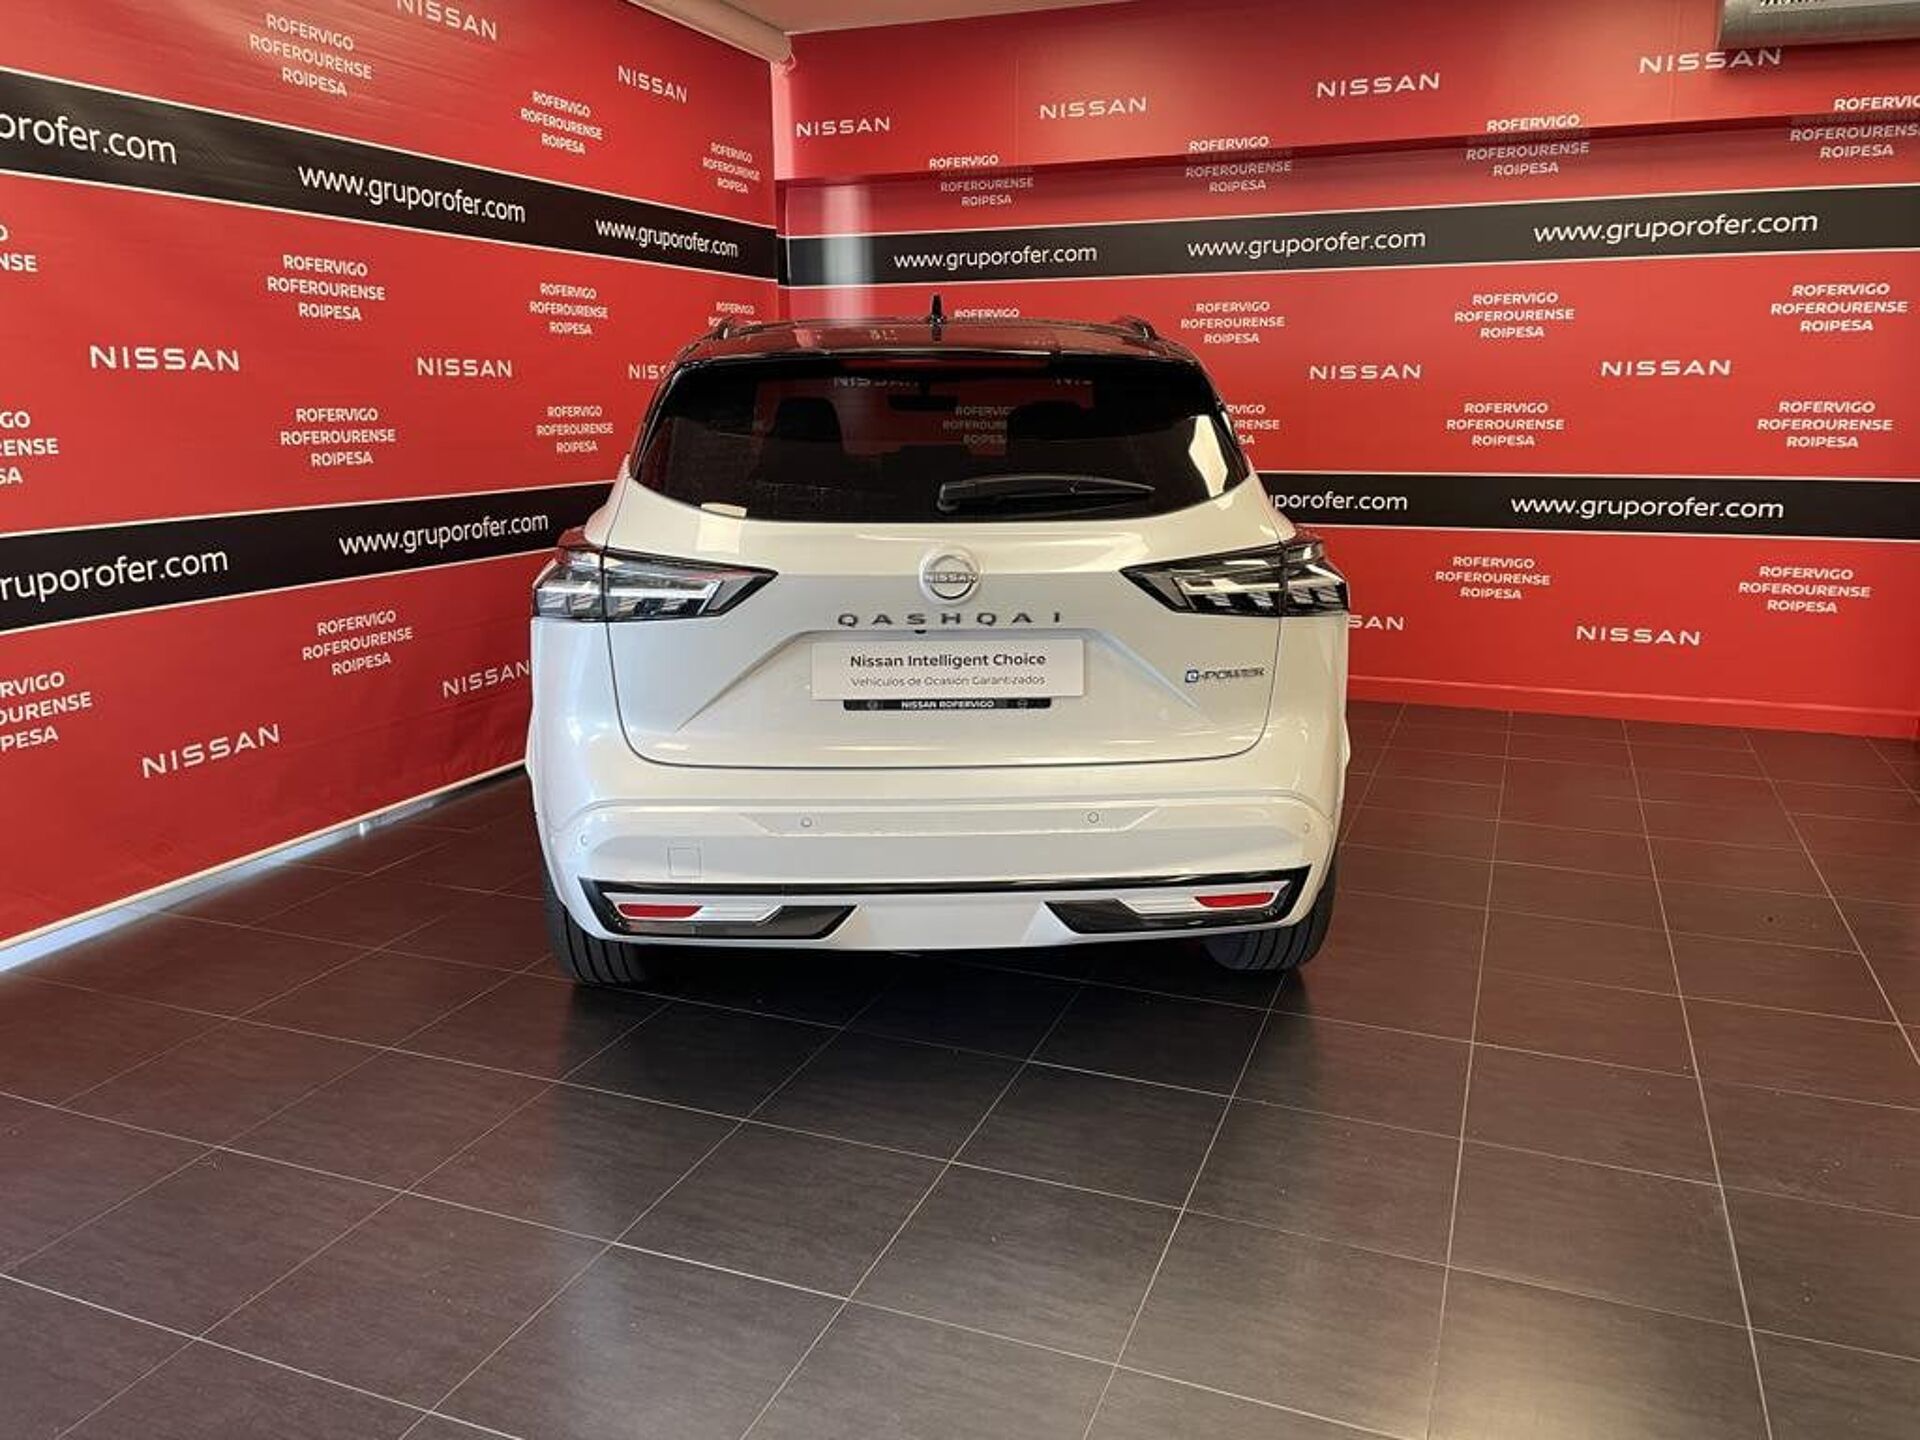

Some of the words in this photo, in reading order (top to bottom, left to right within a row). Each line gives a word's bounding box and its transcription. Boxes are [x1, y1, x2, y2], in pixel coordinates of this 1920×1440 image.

[396, 0, 497, 41] NISSAN
[266, 13, 354, 51] ROFERVIGO
[249, 34, 373, 80] ROFEROURENSE
[1640, 48, 1780, 75] NISSAN
[282, 67, 348, 97] ROIPESA
[617, 64, 688, 104] NISSAN
[1317, 73, 1440, 99] NISSAN
[533, 91, 591, 118] ROFERVIGO
[1040, 97, 1147, 120] NISSAN
[521, 108, 603, 140] ROFEROURENSE
[795, 116, 890, 137] NISSAN
[1487, 114, 1580, 132] ROFERVIGO
[541, 132, 586, 155] ROIPESA
[1189, 136, 1269, 152] ROFERVIGO
[1466, 142, 1590, 161] ROFEROURENSE
[1820, 144, 1894, 158] ROIPESA
[929, 154, 999, 170] ROFERVIGO
[1185, 160, 1292, 178] ROFEROURENSE
[1493, 162, 1559, 177] ROIPESA
[298, 165, 526, 223] www.gruporofer.com
[1209, 179, 1266, 193] ROIPESA
[961, 194, 1012, 207] ROIPESA
[1534, 214, 1818, 244] www.gruporofer.com
[596, 219, 738, 258] www.gruporofer.com
[1187, 230, 1425, 260] www.gruporofer.com
[282, 254, 368, 277] ROFERVIGO
[894, 245, 1098, 271] www.gruporofer.com
[267, 277, 385, 300] ROFEROURENSE
[540, 283, 597, 300] ROFERVIGO
[1792, 283, 1890, 298] ROFERVIGO
[1195, 301, 1270, 313] ROFERVIGO
[1472, 292, 1558, 306] ROFERVIGO
[298, 302, 362, 321] ROIPESA
[529, 301, 608, 320] ROFEROURENSE
[1454, 308, 1575, 322] ROFEROURENSE
[1771, 301, 1908, 316] ROFEROURENSE
[548, 321, 593, 335] ROIPESA
[1180, 316, 1285, 329] ROFEROURENSE
[1800, 319, 1873, 332] ROIPESA
[1203, 332, 1260, 345] ROIPESA
[1480, 326, 1544, 339] ROIPESA
[90, 345, 240, 372] NISSAN
[417, 357, 513, 379] NISSAN
[1310, 364, 1421, 380] NISSAN
[1600, 360, 1731, 377] NISSAN
[296, 408, 379, 424] ROFERVIGO
[547, 405, 602, 418] ROFERVIGO
[1464, 402, 1548, 414] ROFERVIGO
[1779, 401, 1875, 414] ROFERVIGO
[537, 422, 614, 437] ROFEROURENSE
[1446, 418, 1564, 431] ROFEROURENSE
[1757, 418, 1893, 431] ROFEROURENSE
[281, 429, 396, 446] ROFEROURENSE
[1471, 434, 1535, 447] ROIPESA
[1786, 436, 1858, 448] ROIPESA
[556, 440, 598, 453] ROIPESA
[310, 451, 374, 468] ROIPESA
[1511, 496, 1784, 521] www.gruporofer.com
[339, 513, 549, 556] www.gruporofer.com
[1452, 556, 1535, 569] ROFERVIGO
[1435, 571, 1550, 586] ROFEROURENSE
[1759, 565, 1853, 580] ROFERVIGO
[1460, 587, 1522, 599] ROIPESA
[1739, 581, 1870, 598] ROFEROURENSE
[1767, 599, 1838, 614] ROIPESA
[317, 609, 397, 636] ROFERVIGO
[838, 612, 1061, 627] QASHQAI
[302, 627, 413, 660] ROFEROURENSE
[1576, 625, 1700, 646] NISSAN
[331, 652, 391, 676] ROIPESA
[850, 655, 904, 668] Nissan
[908, 654, 989, 670] Intelligent
[993, 653, 1046, 666] Choice
[442, 659, 530, 699] NISSAN
[907, 675, 921, 686] de
[901, 701, 937, 709] NISSAN
[939, 700, 995, 709] ROFERVIGO
[141, 723, 280, 779] NISSAN
